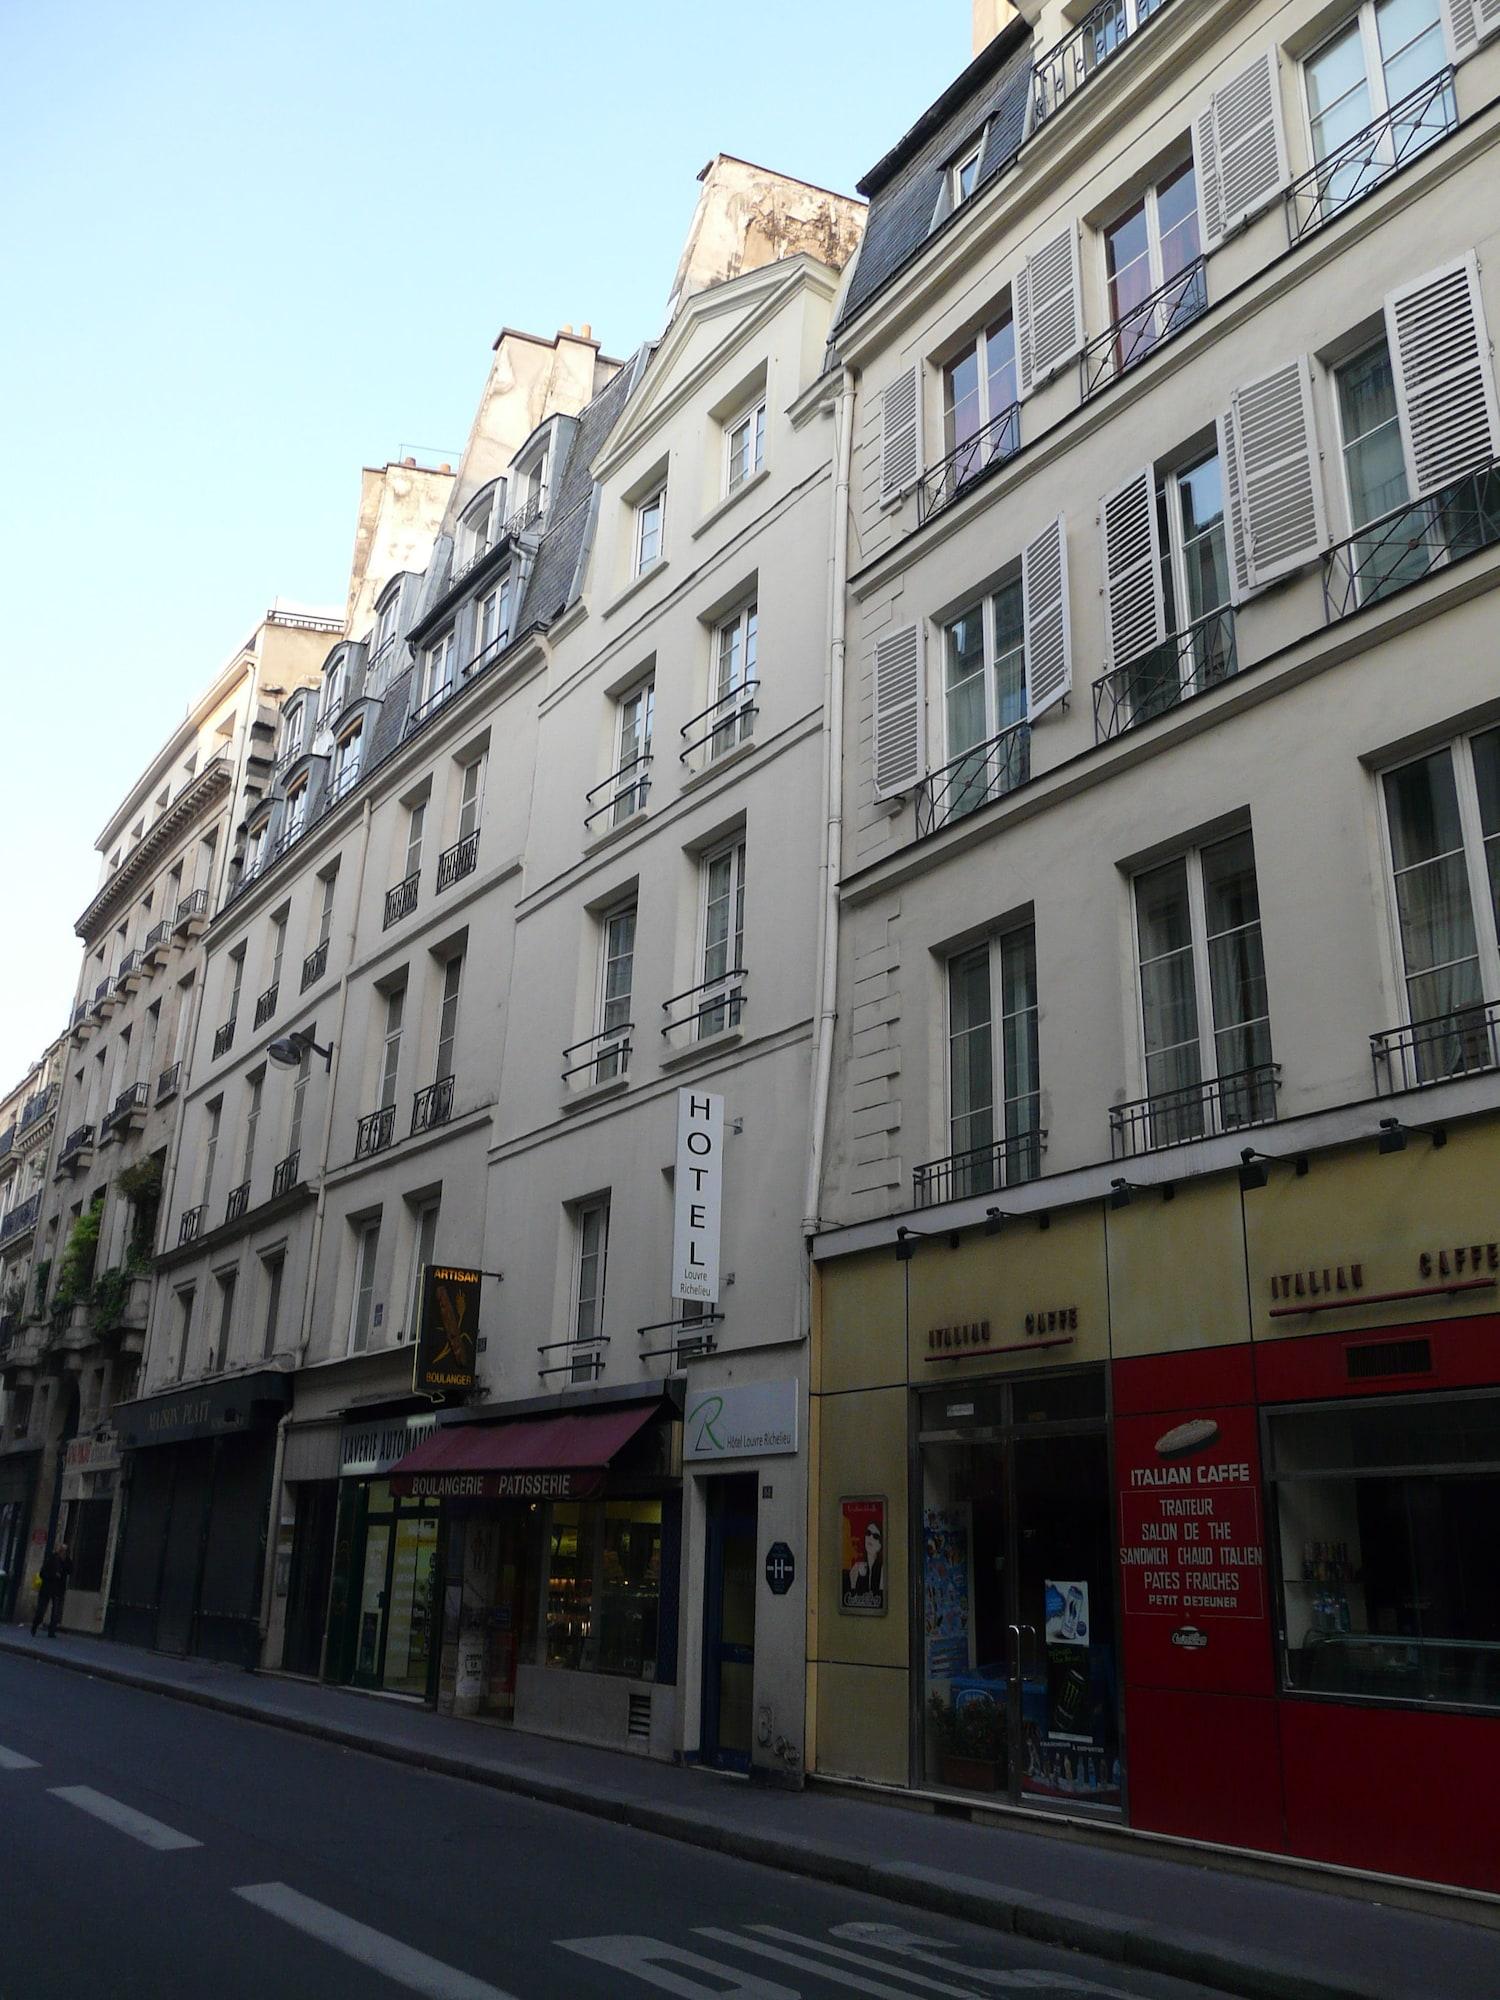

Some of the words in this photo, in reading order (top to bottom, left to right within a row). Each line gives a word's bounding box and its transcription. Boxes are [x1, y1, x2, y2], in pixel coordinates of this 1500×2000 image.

[687, 1096, 711, 1266] HOTEL
[434, 1269, 478, 1283] ARTISAN
[685, 1270, 707, 1281] Louvre
[1271, 1264, 1363, 1299] ITALIAN
[1419, 1242, 1500, 1278] CAFFE
[680, 1283, 710, 1297] Richelieu
[928, 1320, 991, 1349] ITALIAN
[1025, 1308, 1077, 1335] CAFFE
[426, 1372, 471, 1385] BOULANGER
[343, 1432, 377, 1464] LAVERIE
[744, 1435, 763, 1448] Louvre
[764, 1431, 791, 1446] Richelieu
[1131, 1467, 1191, 1486] ITALIAN
[1197, 1463, 1250, 1483] CAFFE
[412, 1476, 484, 1495] BOULANGERIE
[498, 1474, 570, 1494] PATISSERIE
[1160, 1498, 1214, 1516] TRAITEUR
[1142, 1523, 1177, 1540] SALON
[1184, 1523, 1199, 1540] DE
[1207, 1522, 1231, 1540] THE
[1120, 1547, 1168, 1564] SANDWICH
[1177, 1547, 1213, 1564] CHAUD
[1220, 1547, 1262, 1565] ITALIEN
[1144, 1572, 1180, 1589] PATES
[1186, 1572, 1239, 1590] FRAICHES
[1149, 1595, 1178, 1606] PETIT
[1183, 1595, 1237, 1608] DEJEUNER
